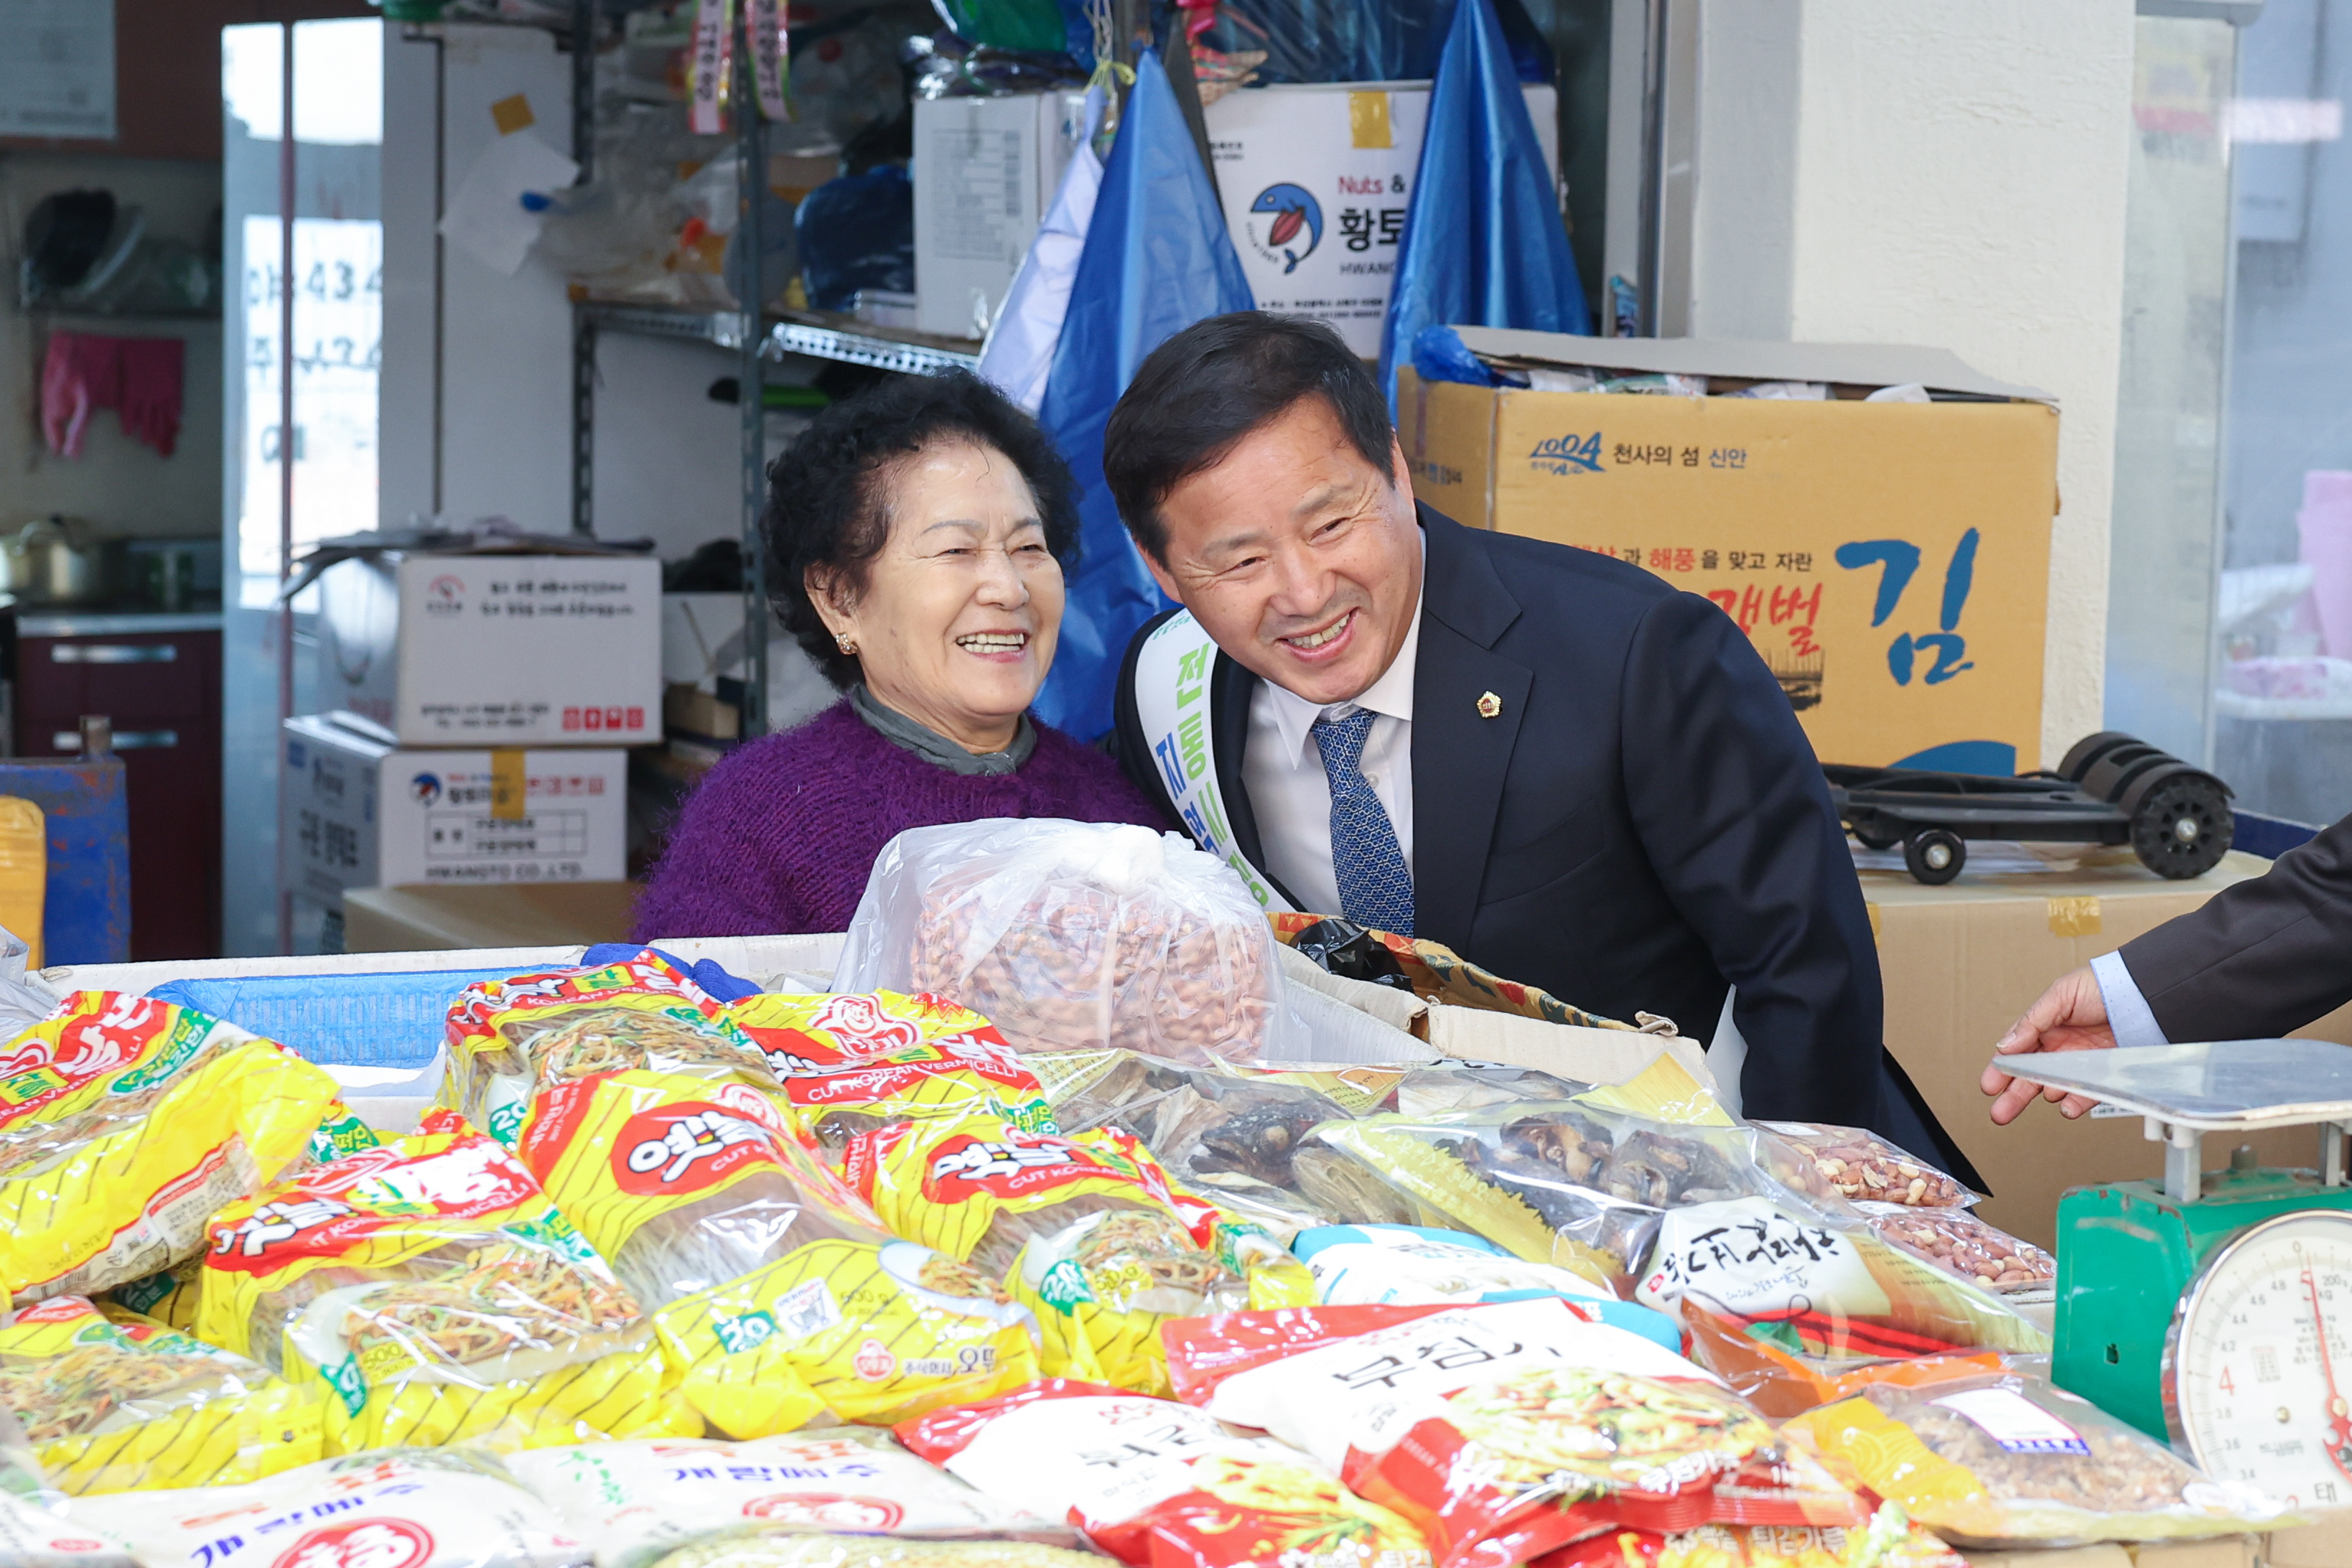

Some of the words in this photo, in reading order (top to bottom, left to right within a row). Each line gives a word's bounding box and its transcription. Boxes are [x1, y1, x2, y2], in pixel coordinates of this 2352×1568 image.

[1339, 177, 1384, 194] Nuts
[1613, 444, 1673, 466] 천사의
[1681, 447, 1700, 467] 섬
[1709, 447, 1747, 469] 신안
[1728, 551, 1766, 571] 맞고
[1775, 551, 1813, 571] 자란
[1834, 527, 1980, 686] 김
[922, 1058, 1019, 1078] VERMICELLI
[709, 1147, 747, 1171] CUT
[1009, 1169, 1047, 1190] CUT
[2271, 1280, 2287, 1292] 4.8
[2250, 1294, 2267, 1306] 4.6
[2232, 1313, 2248, 1325] 4.4
[719, 1315, 773, 1351] 20
[2221, 1340, 2236, 1352] 4.2
[2219, 1366, 2235, 1396] 4
[2225, 1438, 2241, 1450] 3.6
